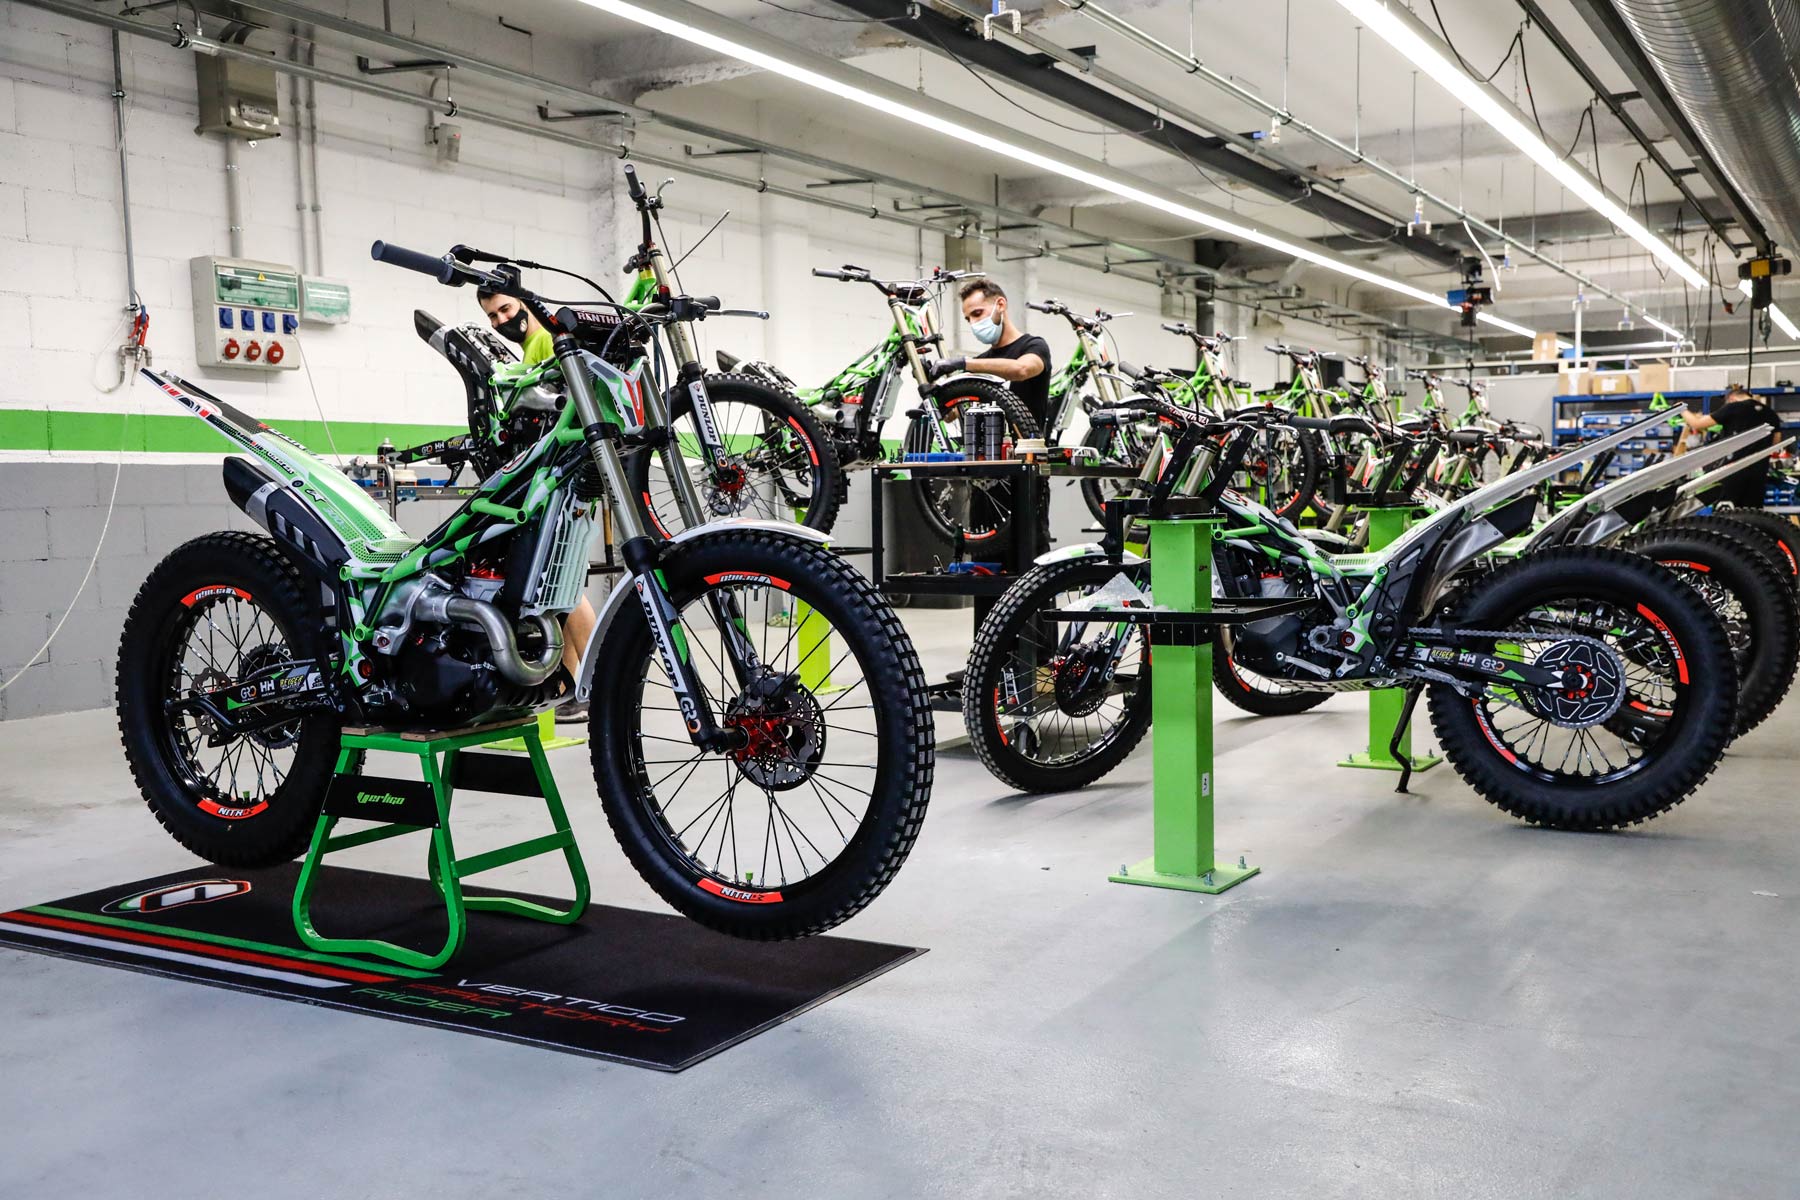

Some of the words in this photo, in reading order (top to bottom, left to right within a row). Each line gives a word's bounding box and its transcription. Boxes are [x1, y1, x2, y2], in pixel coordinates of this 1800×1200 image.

[697, 394, 717, 442] DUNLOP
[643, 601, 679, 688] DUNLOP
[1459, 653, 1476, 664] HH
[1481, 658, 1505, 671] GRO
[240, 685, 257, 698] GRO
[260, 680, 275, 692] HH
[680, 696, 701, 734] GRO
[350, 988, 513, 1019] RIDER
[406, 983, 673, 1033] FACTORY
